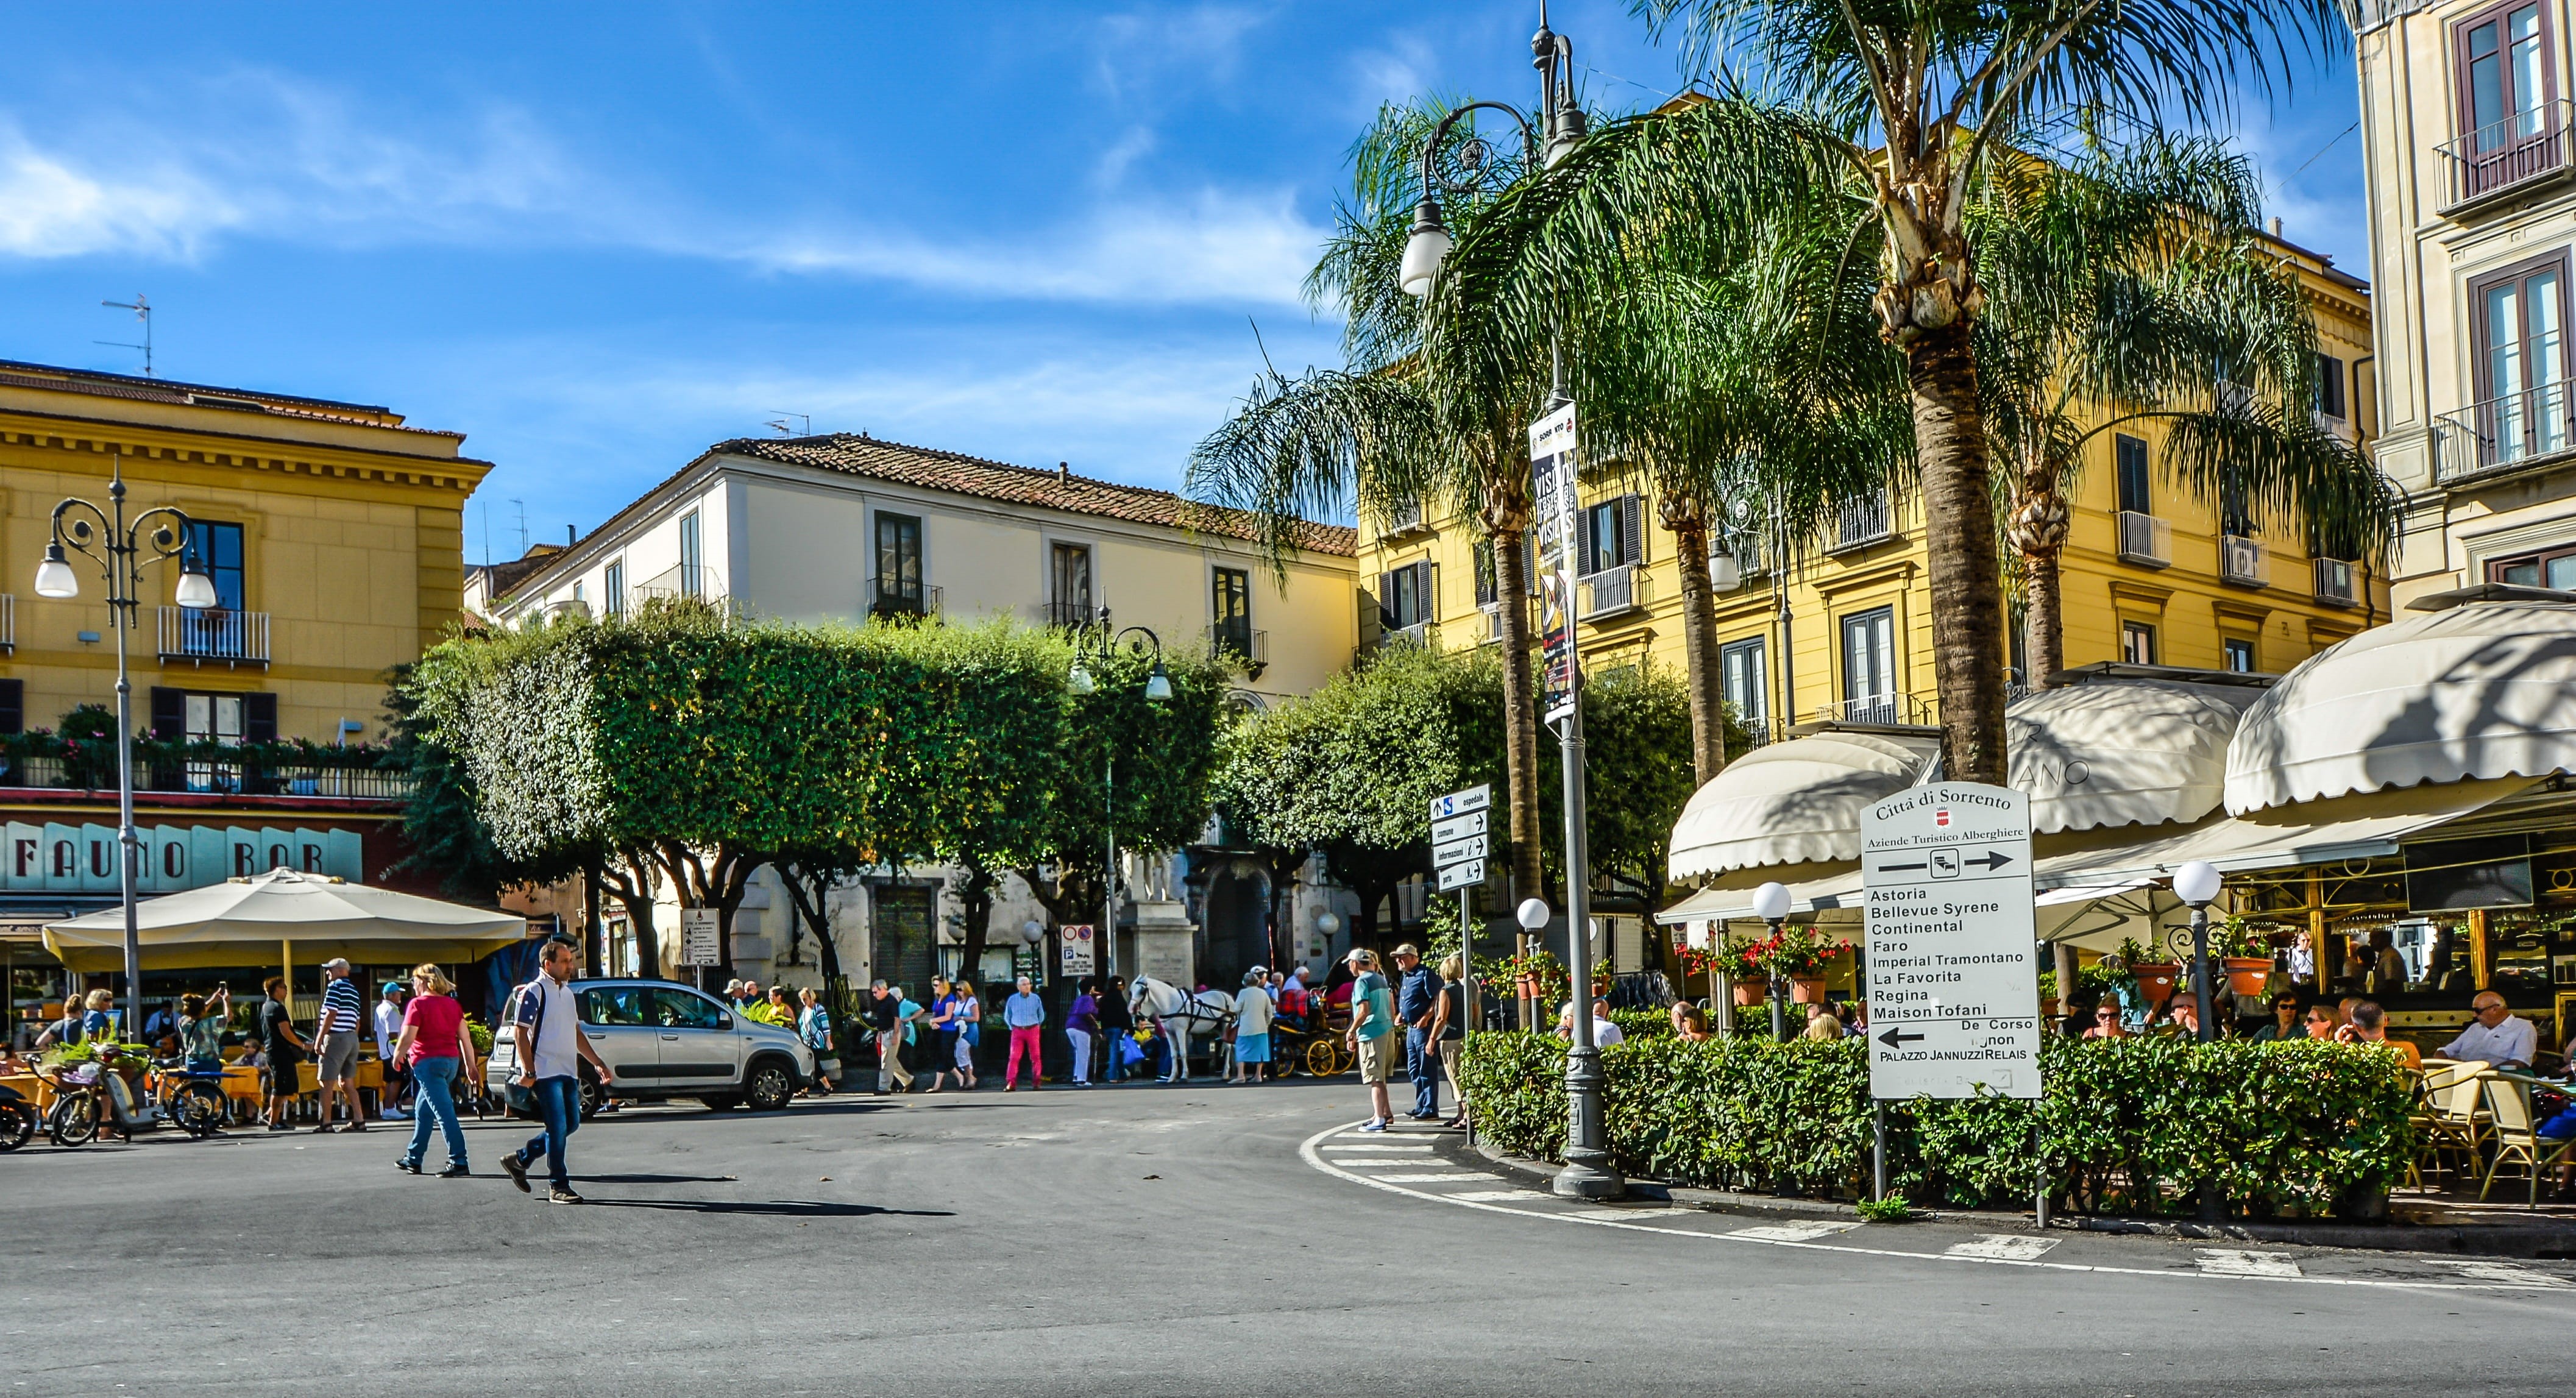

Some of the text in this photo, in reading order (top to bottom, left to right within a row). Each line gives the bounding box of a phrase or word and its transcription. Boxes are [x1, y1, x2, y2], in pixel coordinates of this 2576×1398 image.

[1539, 423, 1564, 441] SORRNTO
[1535, 453, 1574, 499] visini
[1536, 478, 1574, 511] trasveali
[1537, 495, 1574, 524] transvse
[1463, 793, 1484, 806] ospedale
[1876, 789, 2011, 820] Città di Sorrento
[1437, 828, 1454, 838] comune
[1867, 828, 2024, 848] Aziende Turistico Alberghiere
[15, 839, 322, 878] FAUNO BAR
[1438, 846, 1463, 860] informazioni
[1870, 888, 1927, 902] Astoria
[1872, 906, 1939, 919] Bellevue
[1943, 902, 1999, 918] Syrene
[1872, 920, 1963, 935] Continental
[1873, 941, 1908, 953] Faro
[1873, 953, 2024, 970] Imperial Tramontano
[1874, 971, 1962, 985] La Favorita
[1875, 989, 1928, 1004] Regina
[1874, 1003, 1987, 1019] Maison Tofani
[1962, 1019, 2033, 1031] De Corso
[1880, 1049, 2027, 1062] PALAZZO JANNUZZI RELAIS
